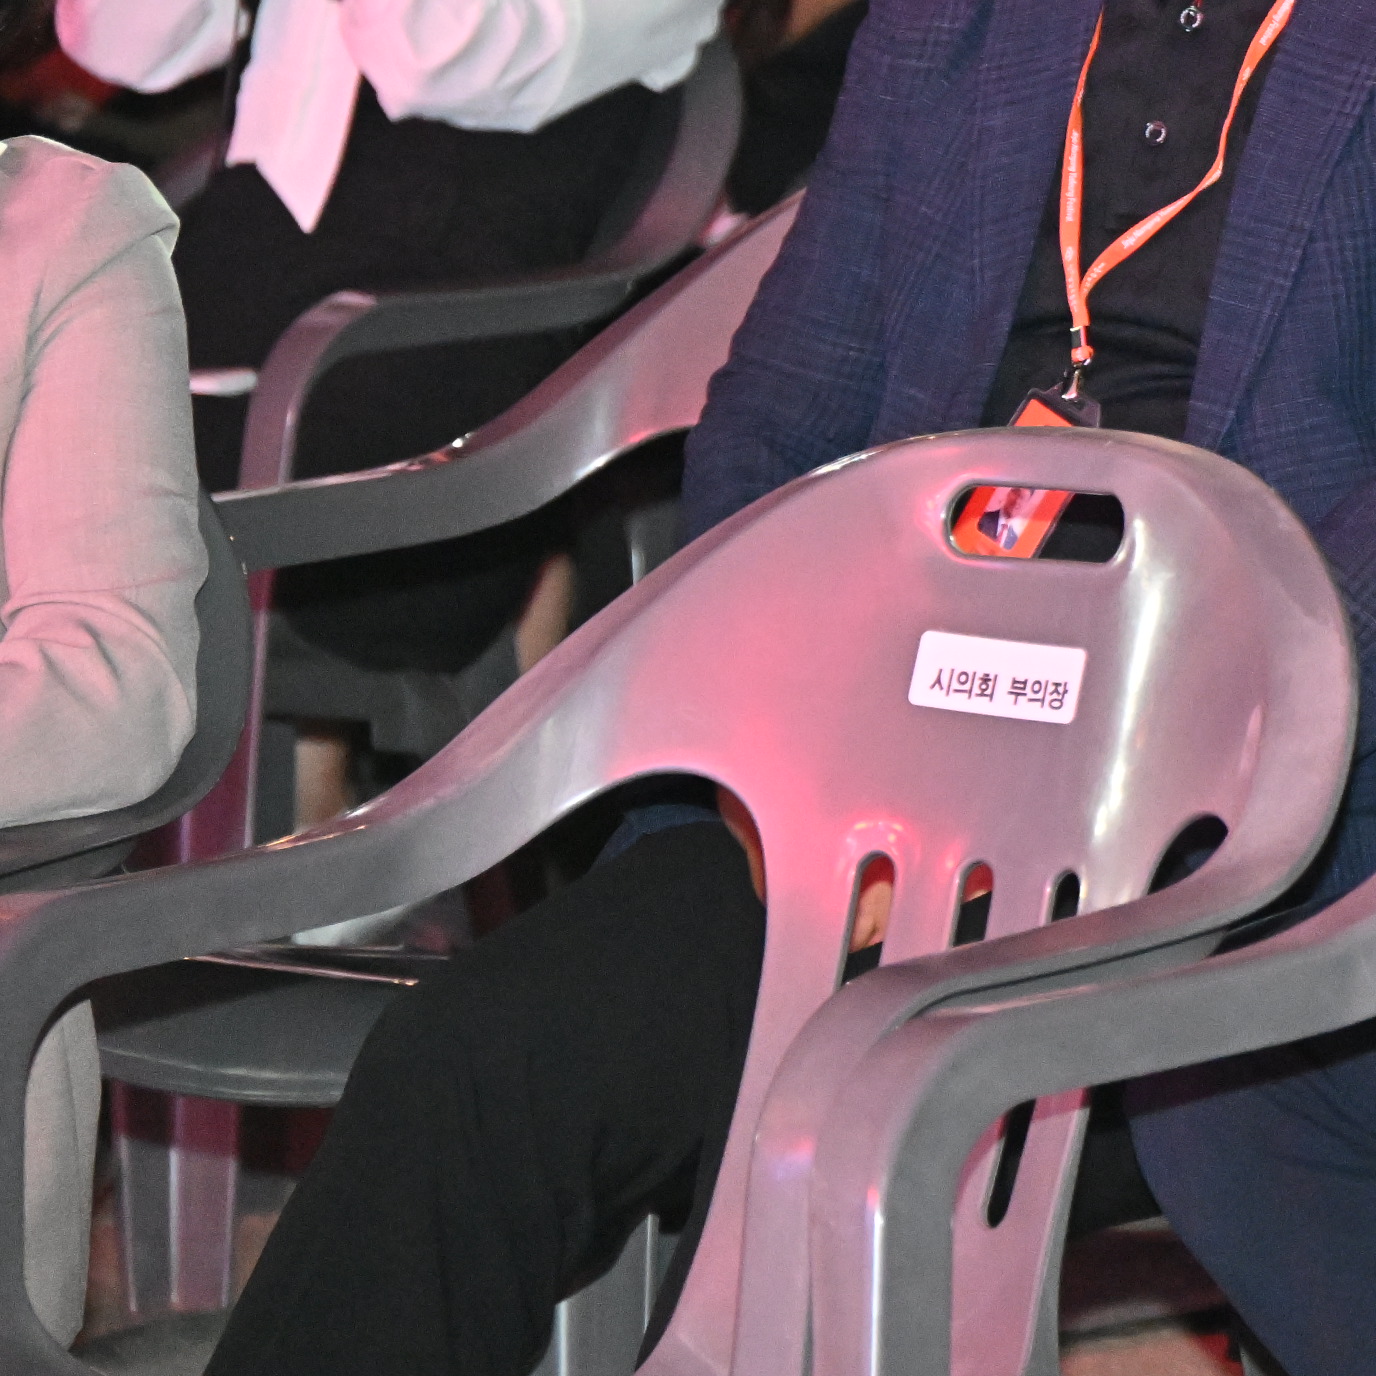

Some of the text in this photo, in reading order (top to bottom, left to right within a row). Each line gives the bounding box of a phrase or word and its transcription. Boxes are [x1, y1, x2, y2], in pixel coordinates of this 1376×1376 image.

[1066, 198, 1076, 221] Festival
[930, 668, 1069, 711] 시의회 부의장
